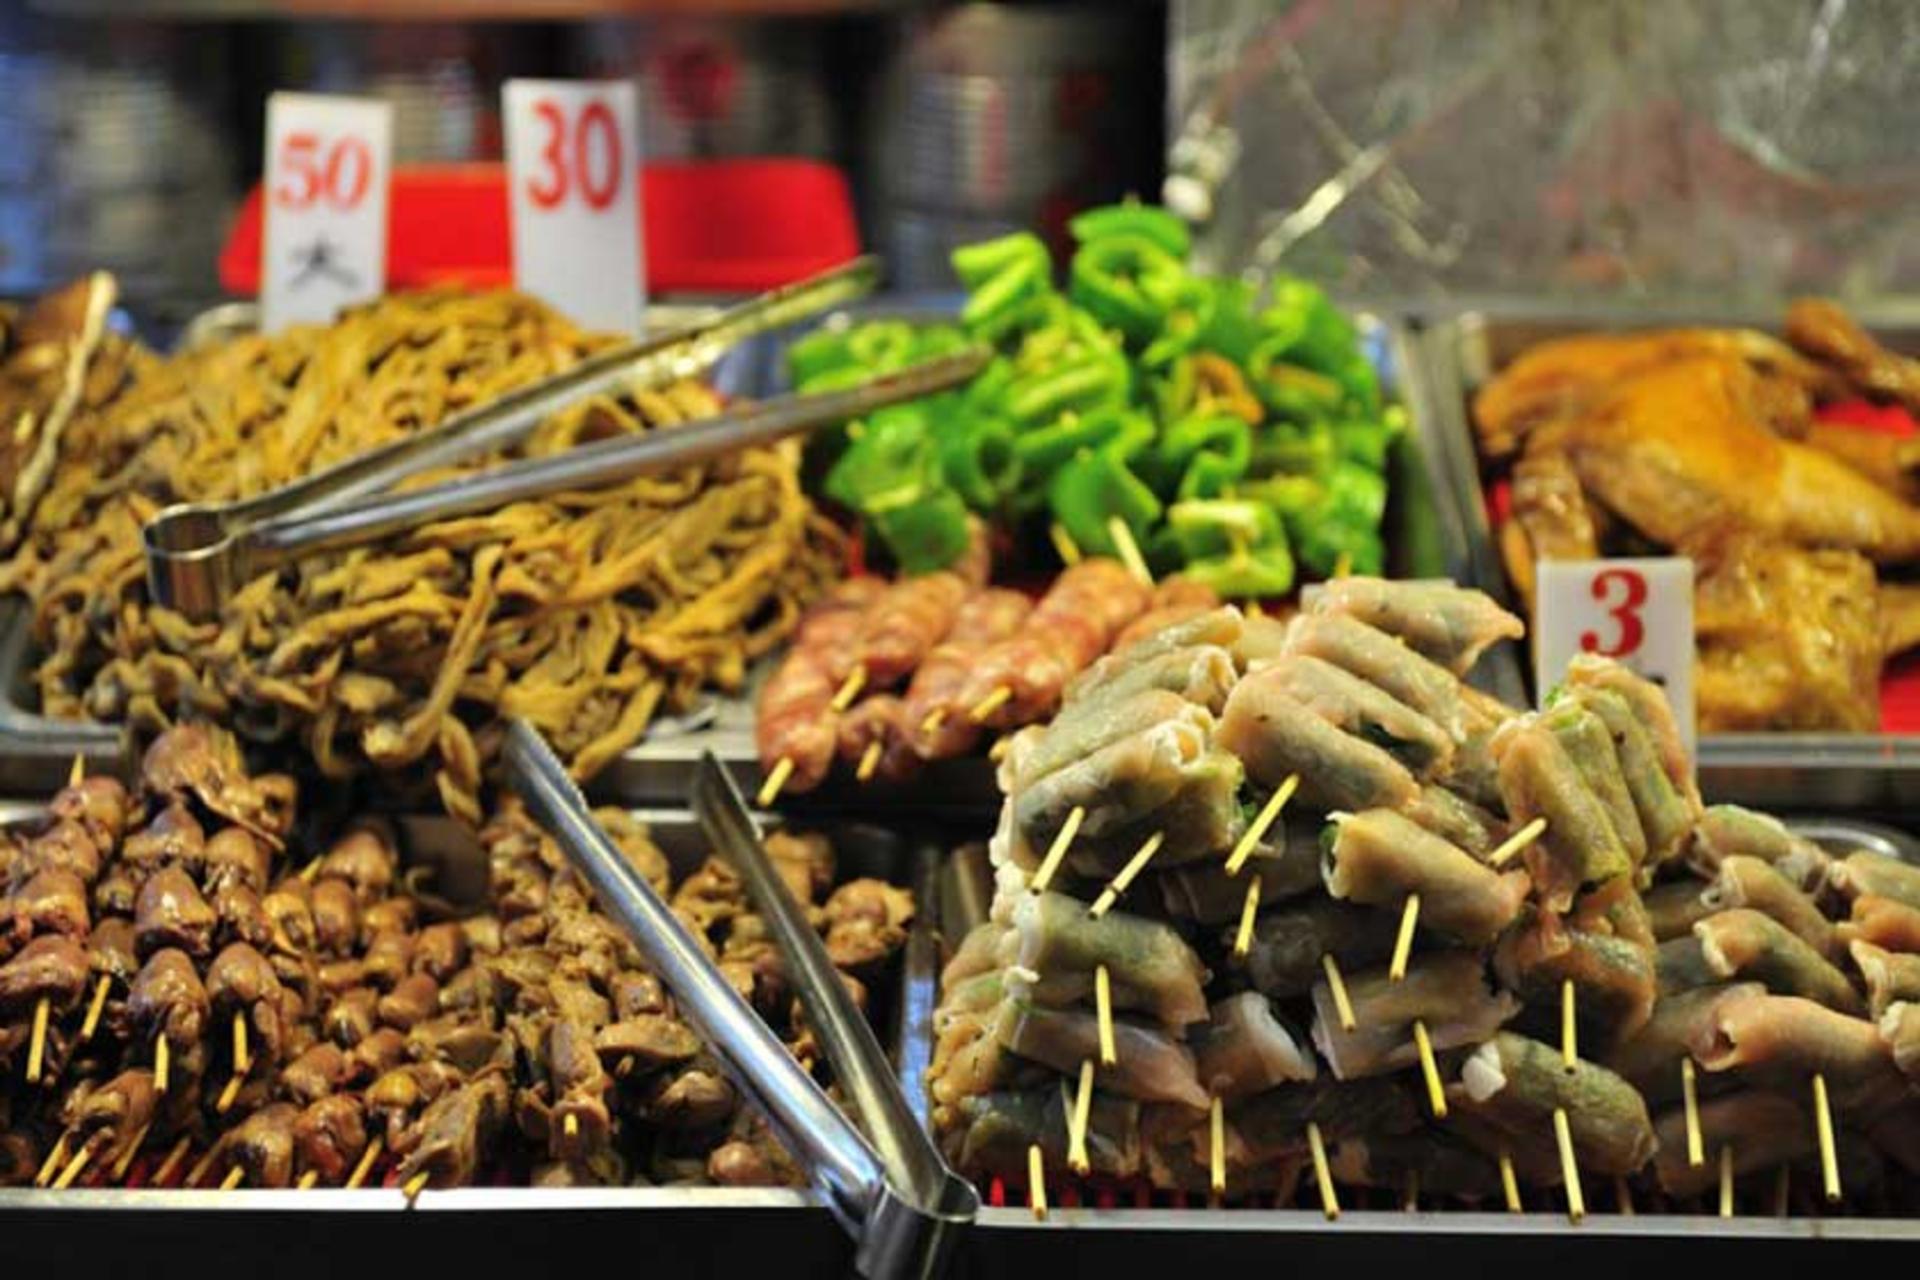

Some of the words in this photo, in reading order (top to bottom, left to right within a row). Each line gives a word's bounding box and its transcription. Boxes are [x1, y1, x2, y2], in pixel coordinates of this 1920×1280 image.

[275, 130, 375, 212] 50
[527, 99, 623, 212] 30
[1579, 568, 1648, 660] 3
